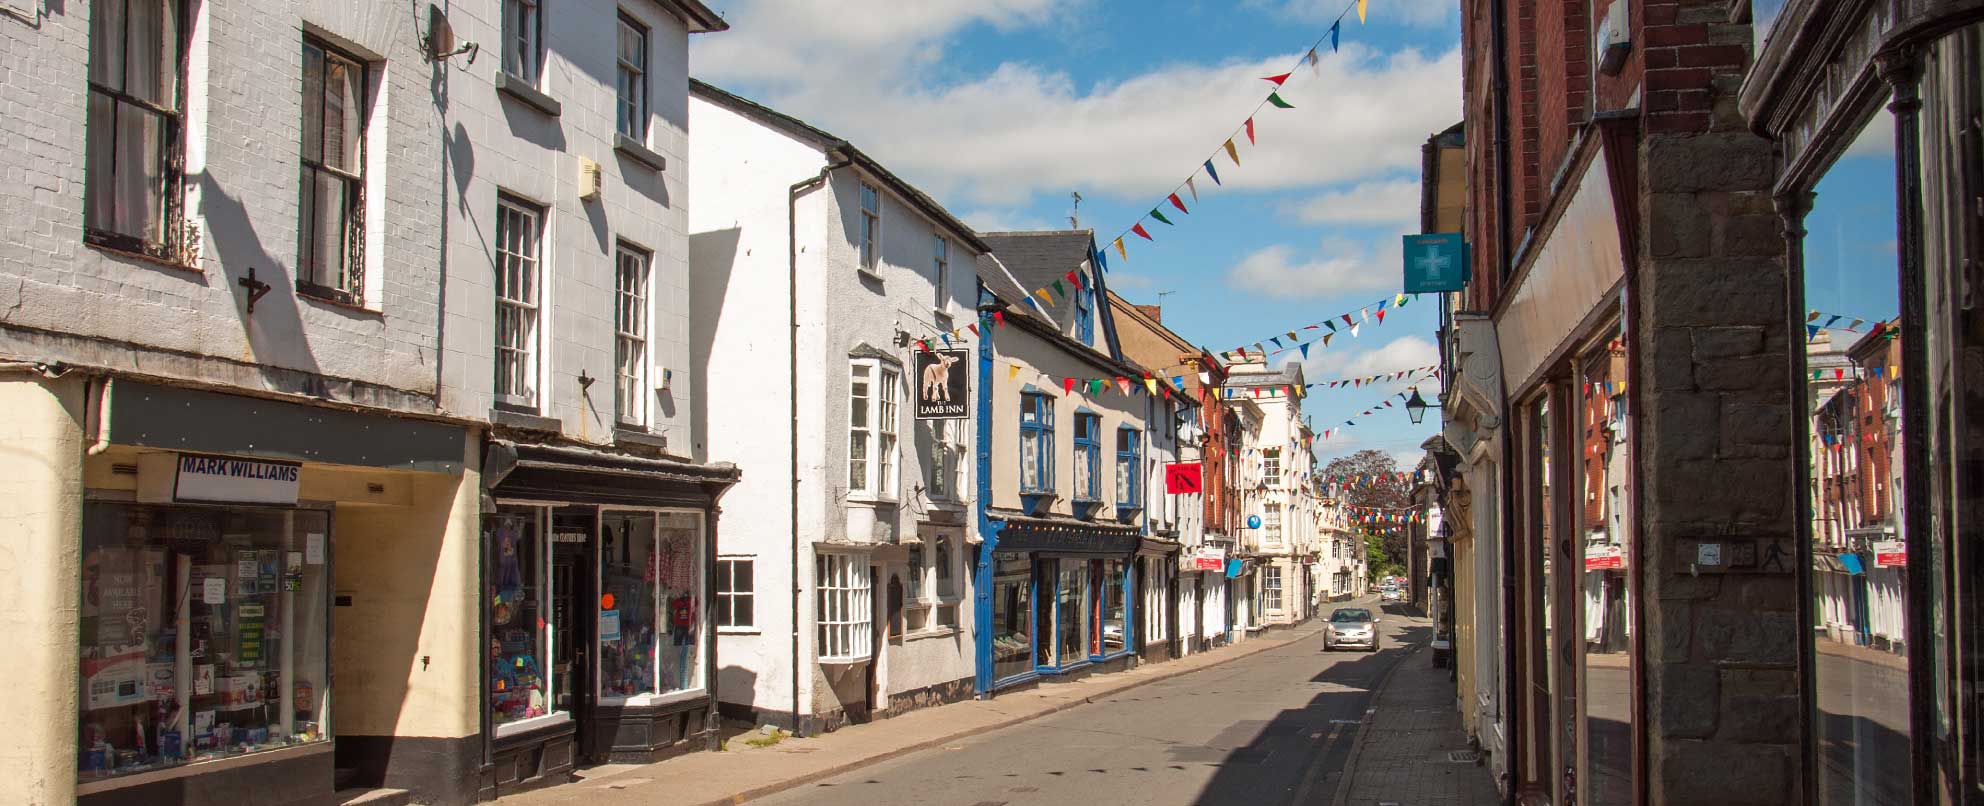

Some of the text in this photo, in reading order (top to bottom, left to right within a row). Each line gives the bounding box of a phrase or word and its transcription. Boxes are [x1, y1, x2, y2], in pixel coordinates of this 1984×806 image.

[921, 405, 963, 414] LAMB INN
[183, 456, 298, 482] MARK WILLIAMS
